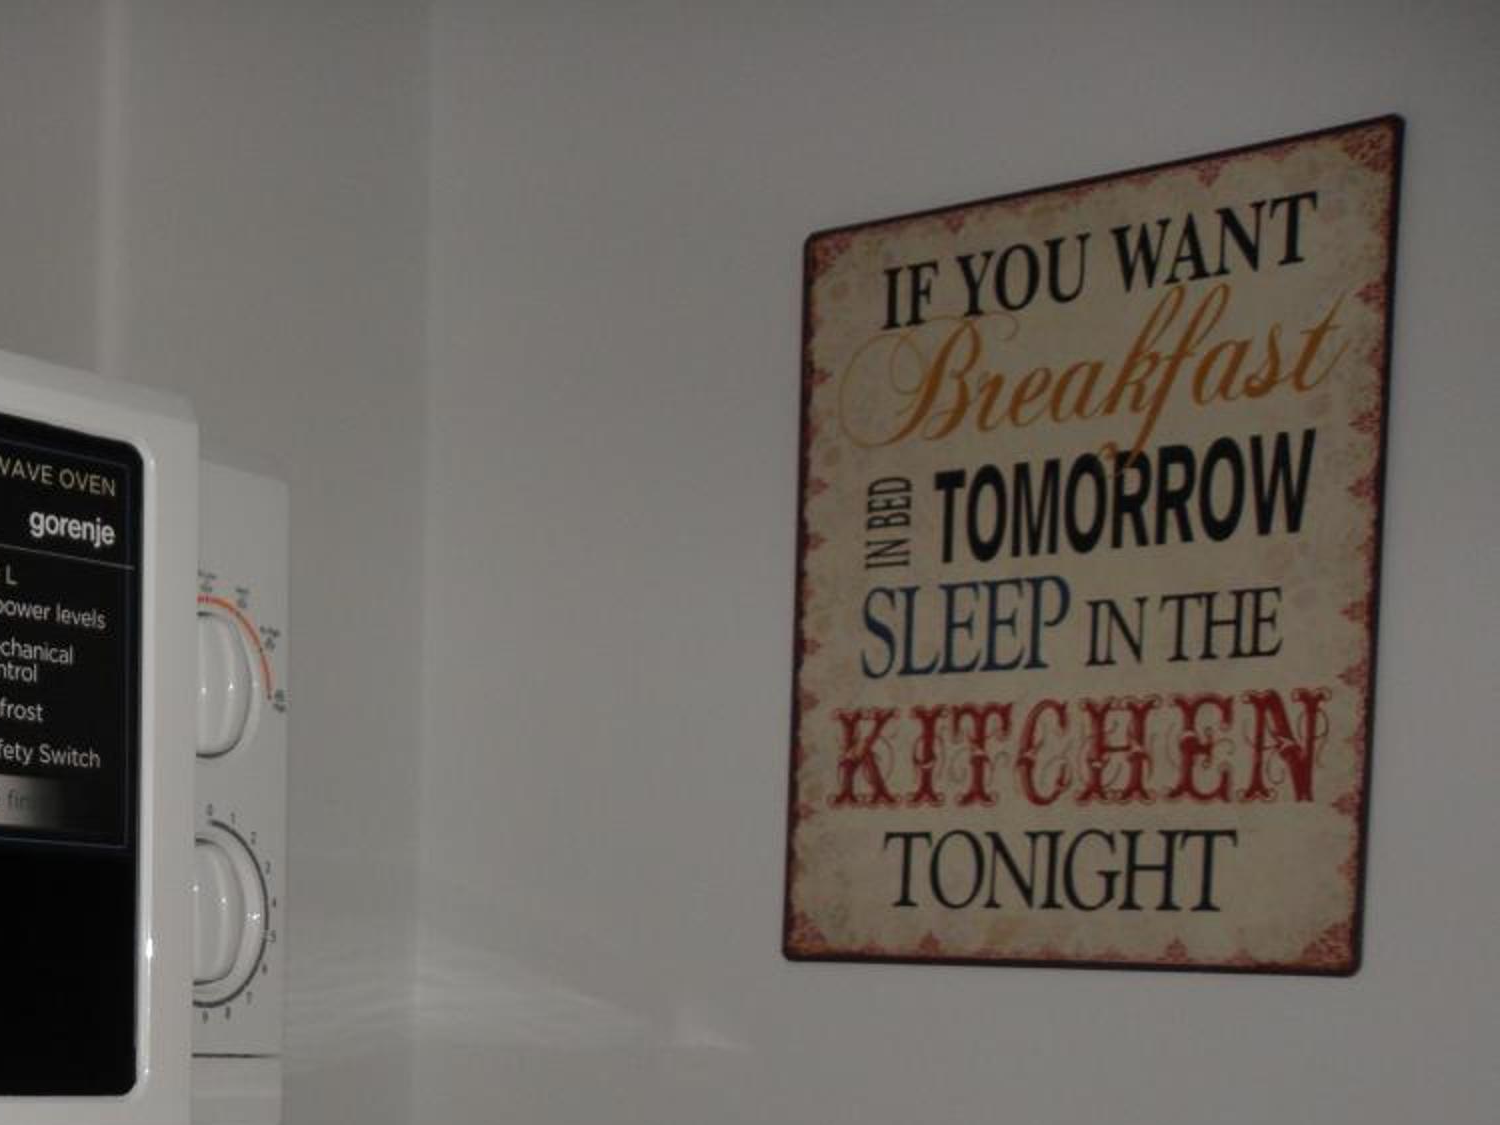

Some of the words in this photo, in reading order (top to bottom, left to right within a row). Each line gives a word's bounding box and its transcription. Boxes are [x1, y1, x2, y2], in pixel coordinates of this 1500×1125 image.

[881, 261, 939, 330] IF
[957, 232, 1092, 316] YOU
[1110, 192, 1318, 291] WANT
[839, 283, 1352, 478] Breakfast
[59, 468, 116, 497] OVEN
[868, 477, 912, 530] BED
[935, 428, 1316, 563] TOMORROW
[29, 511, 116, 548] gorenje
[865, 538, 910, 570] IN
[5, 565, 18, 585] L
[56, 603, 106, 630] levels
[860, 574, 1070, 679] SLEEP
[1085, 596, 1161, 667] IN
[1160, 586, 1284, 663] THE
[39, 743, 101, 769] Switch
[829, 687, 1331, 809] KITCHEN
[883, 829, 1237, 913] TONIGHT
